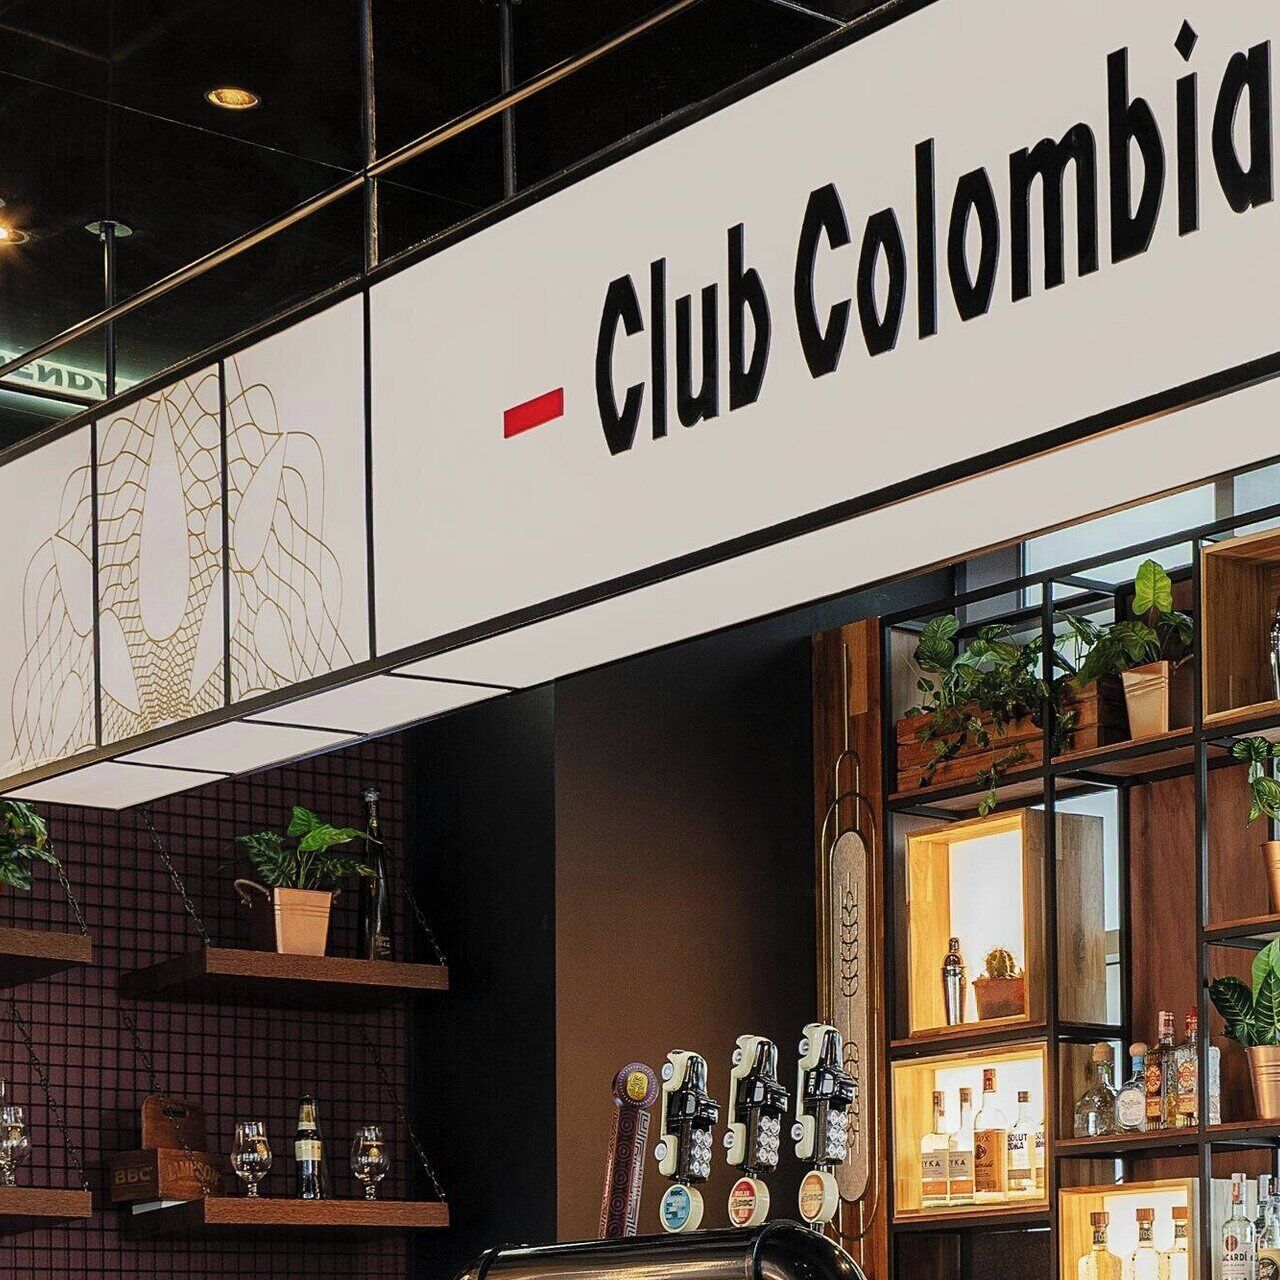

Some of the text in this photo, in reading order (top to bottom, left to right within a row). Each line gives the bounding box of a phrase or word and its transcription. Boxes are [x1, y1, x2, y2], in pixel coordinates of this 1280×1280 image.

[595, 19, 1276, 456] Club Colombia
[1007, 1133, 1028, 1142] SOLUT
[115, 1167, 151, 1184] BBC
